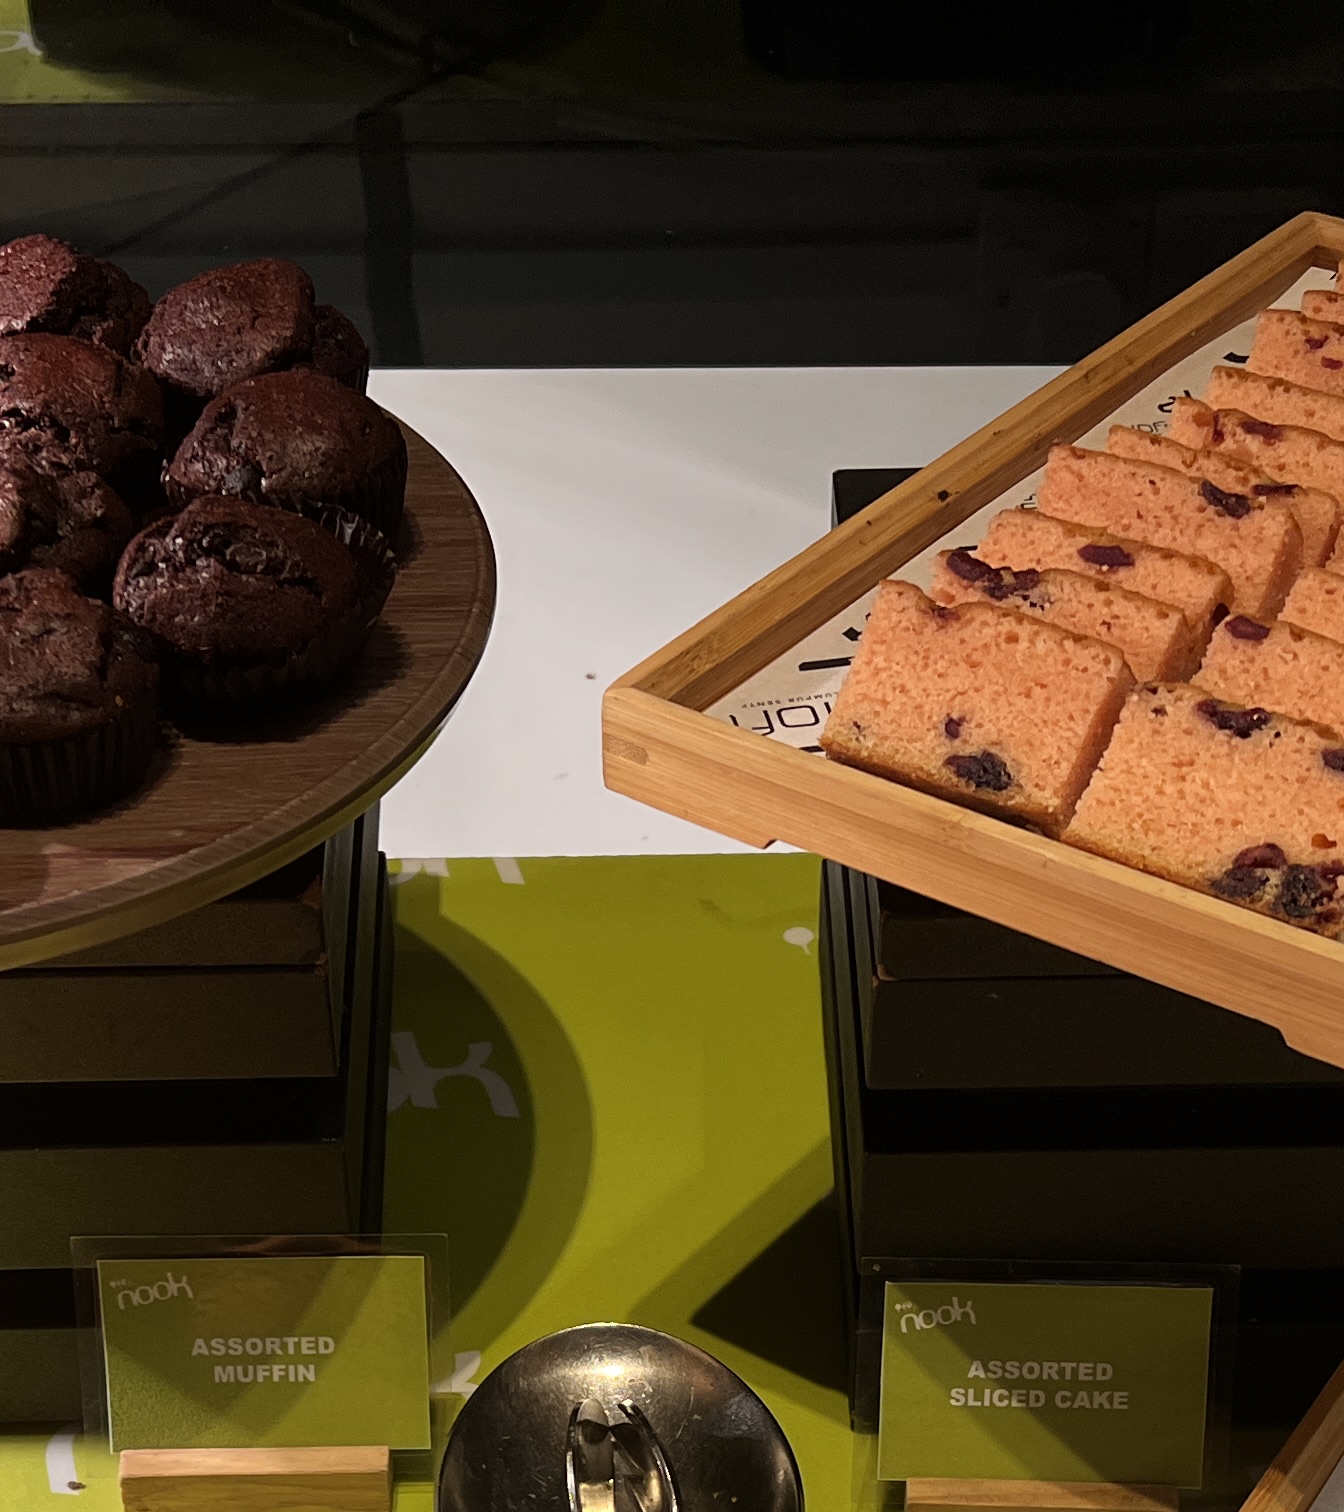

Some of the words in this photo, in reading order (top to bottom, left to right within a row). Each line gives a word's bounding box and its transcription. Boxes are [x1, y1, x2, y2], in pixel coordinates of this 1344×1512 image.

[117, 1272, 194, 1310] nook
[900, 1297, 977, 1333] nook
[191, 1336, 335, 1356] ASSORTED
[214, 1364, 316, 1383] MUFFIN
[967, 1360, 1113, 1381] ASSORTED
[950, 1388, 1046, 1408] SLICED
[1054, 1391, 1129, 1410] CAKE
